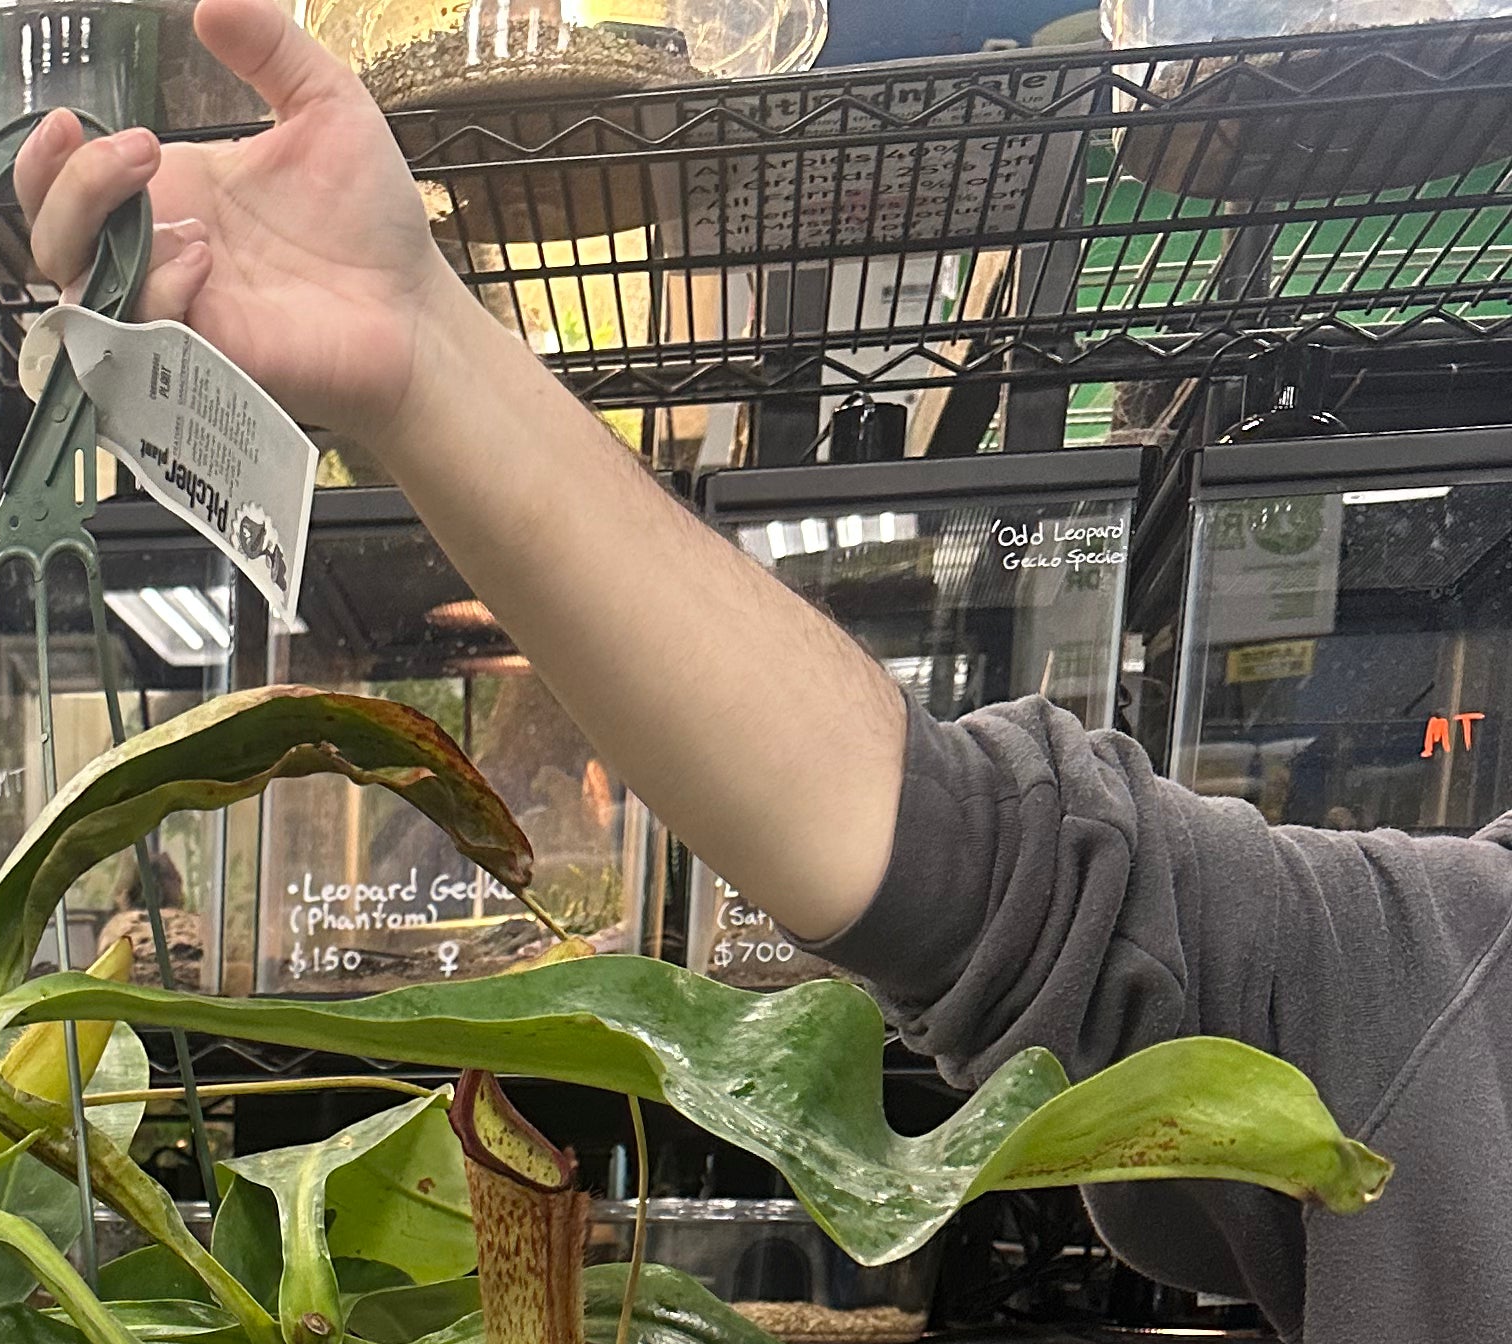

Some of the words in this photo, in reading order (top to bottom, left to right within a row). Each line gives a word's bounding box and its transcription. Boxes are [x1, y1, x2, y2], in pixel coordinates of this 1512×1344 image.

[140, 437, 169, 467] plant
[164, 458, 229, 534] Pitcher
[1054, 518, 1124, 546] Leopard
[1003, 552, 1062, 570] Gecko
[303, 867, 418, 911] Leopard
[290, 902, 439, 936] (Phantom)
[288, 941, 363, 980] $150
[713, 937, 795, 968] $700
